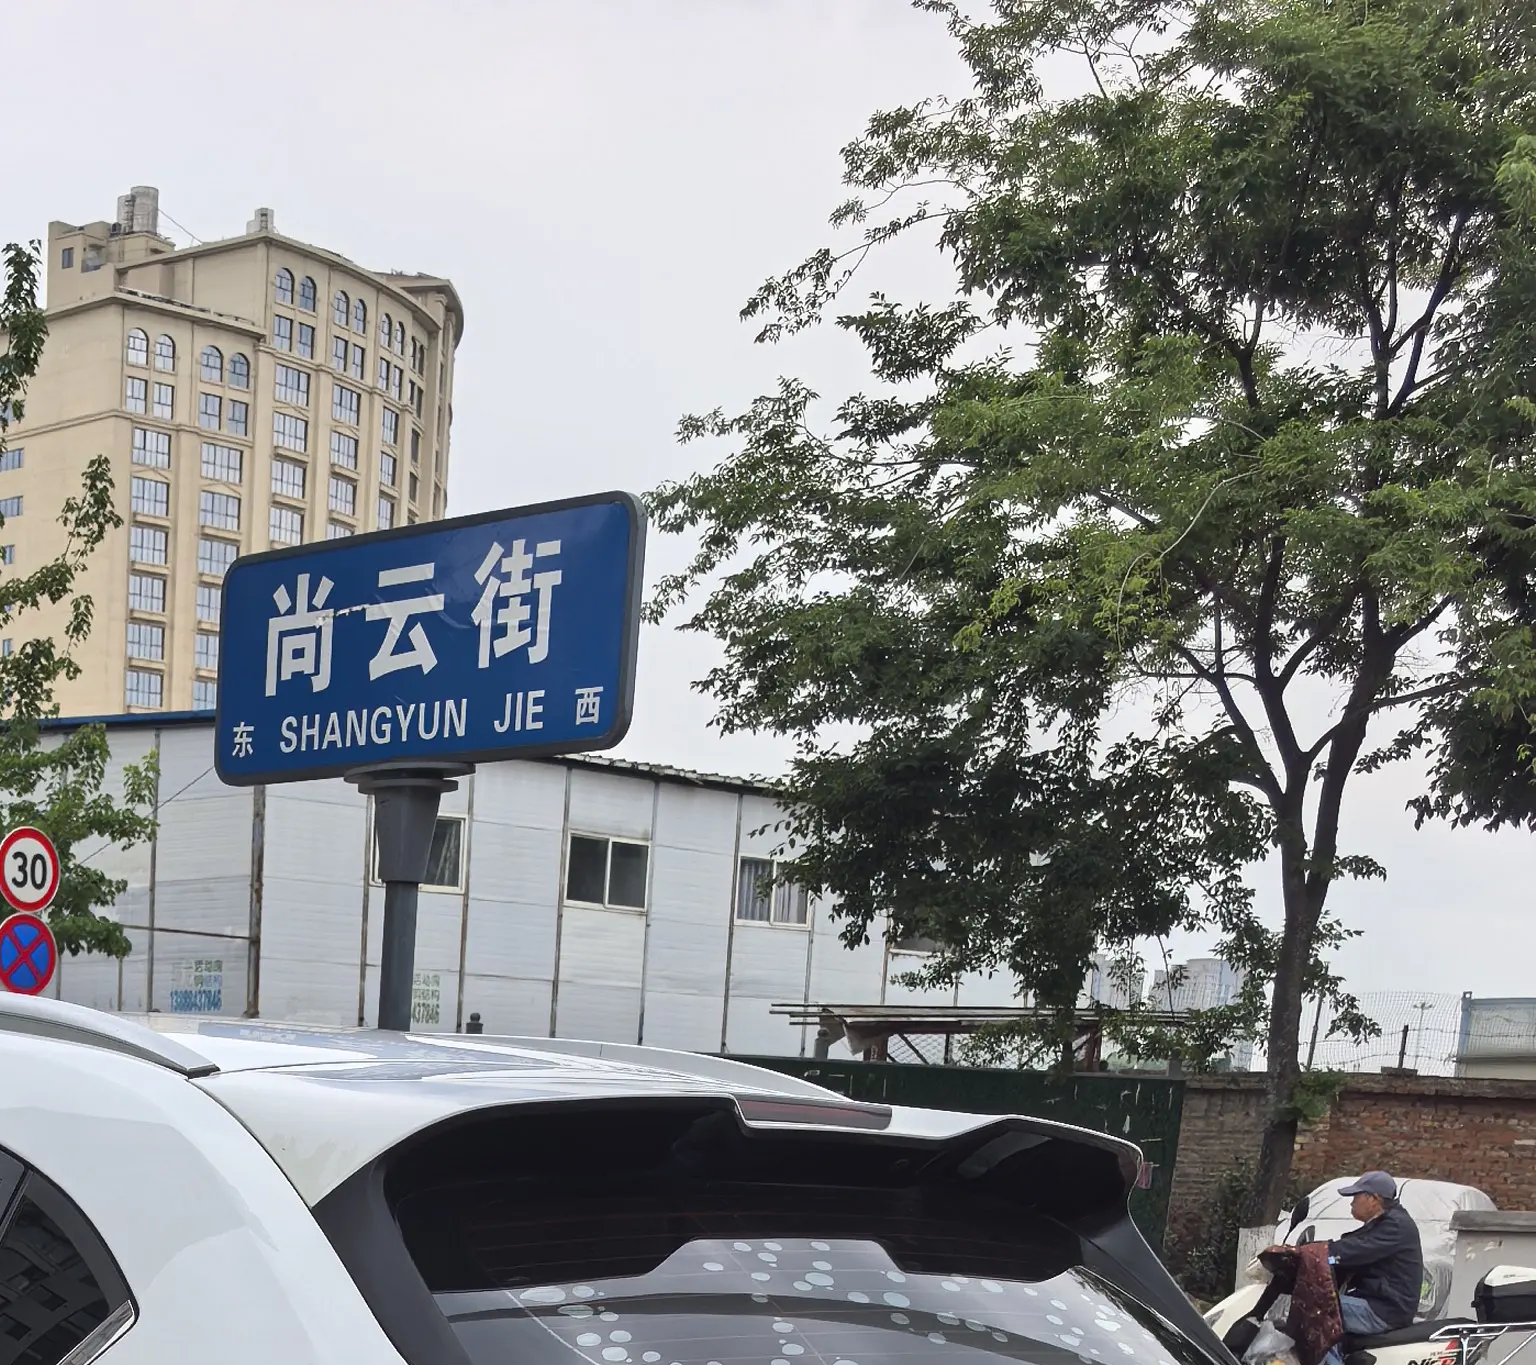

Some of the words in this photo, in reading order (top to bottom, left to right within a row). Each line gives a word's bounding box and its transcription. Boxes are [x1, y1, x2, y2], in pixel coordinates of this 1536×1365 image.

[265, 539, 562, 697] 尚云街
[280, 698, 467, 754] SHANGYUN
[494, 690, 545, 733] JIE
[575, 686, 603, 725] 西
[233, 722, 254, 758] 东
[12, 851, 47, 890] 30
